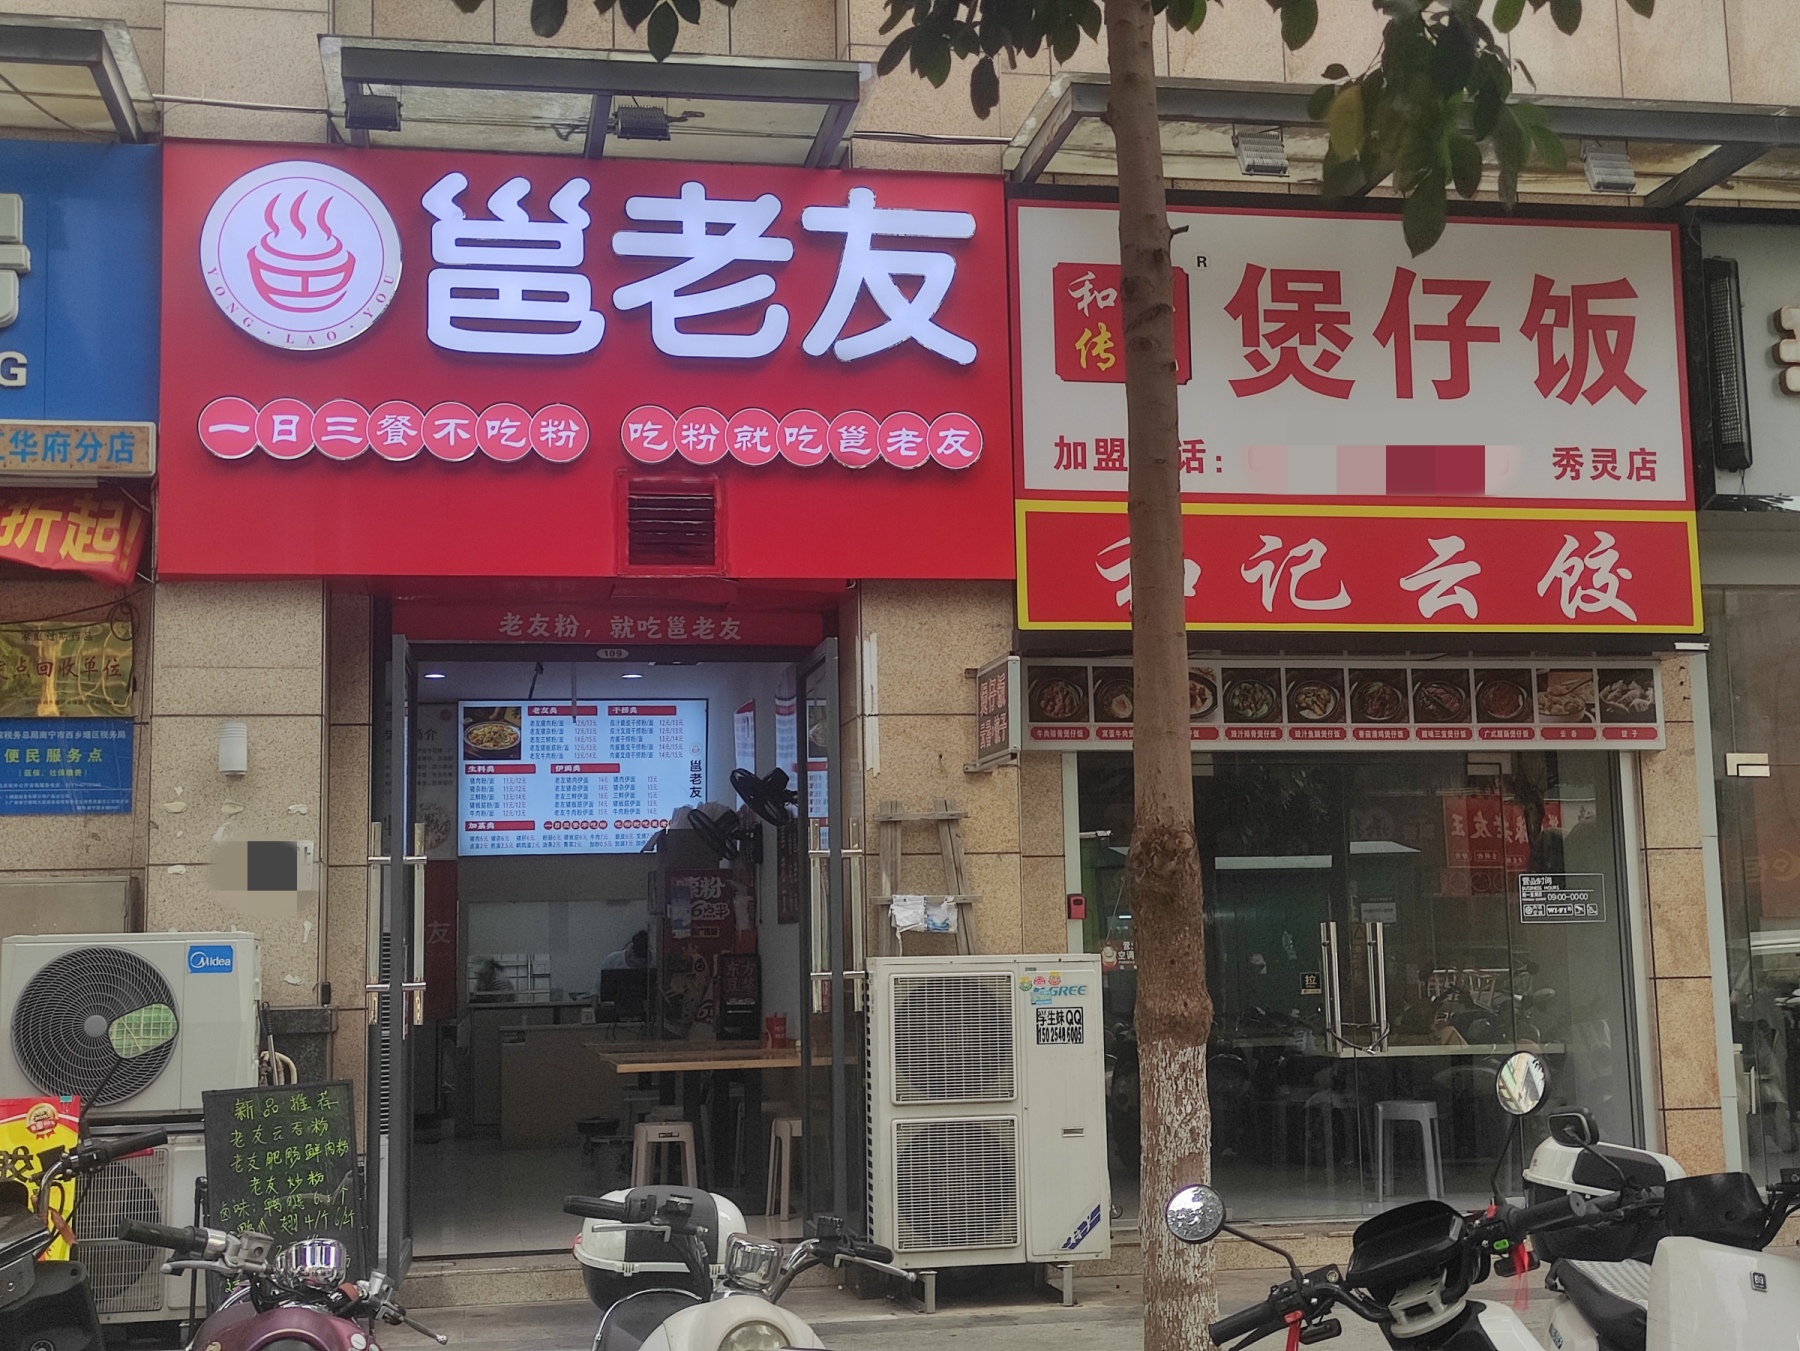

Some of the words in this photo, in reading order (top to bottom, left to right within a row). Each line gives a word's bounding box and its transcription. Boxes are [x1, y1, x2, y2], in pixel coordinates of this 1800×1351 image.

[422, 172, 978, 365] 邕老友
[207, 267, 255, 329] YONG
[286, 330, 337, 345] LAO
[363, 275, 395, 320] YOU
[1224, 263, 1647, 406] 煲仔饭
[0, 430, 135, 464] 华府分店
[207, 412, 578, 449] 一日三餐不吃粉
[629, 421, 974, 458] 吃粉就吃邕老友
[1053, 435, 1224, 475] 加盟话：
[1552, 445, 1658, 483] 秀灵店
[604, 650, 622, 658] 109
[4, 748, 103, 763] 便民服务点
[690, 760, 702, 798] 邕老友
[199, 955, 231, 968] Midea
[1049, 985, 1088, 996] GREE
[1304, 974, 1318, 986] 拉
[1037, 1009, 1082, 1026] 学生妹QQ
[234, 1090, 339, 1121] 新品推荐
[230, 1116, 329, 1148] 老友云吞粉
[230, 1138, 349, 1173] 老友肥肠鲜肉粉
[250, 1170, 325, 1196] 老友炒粉
